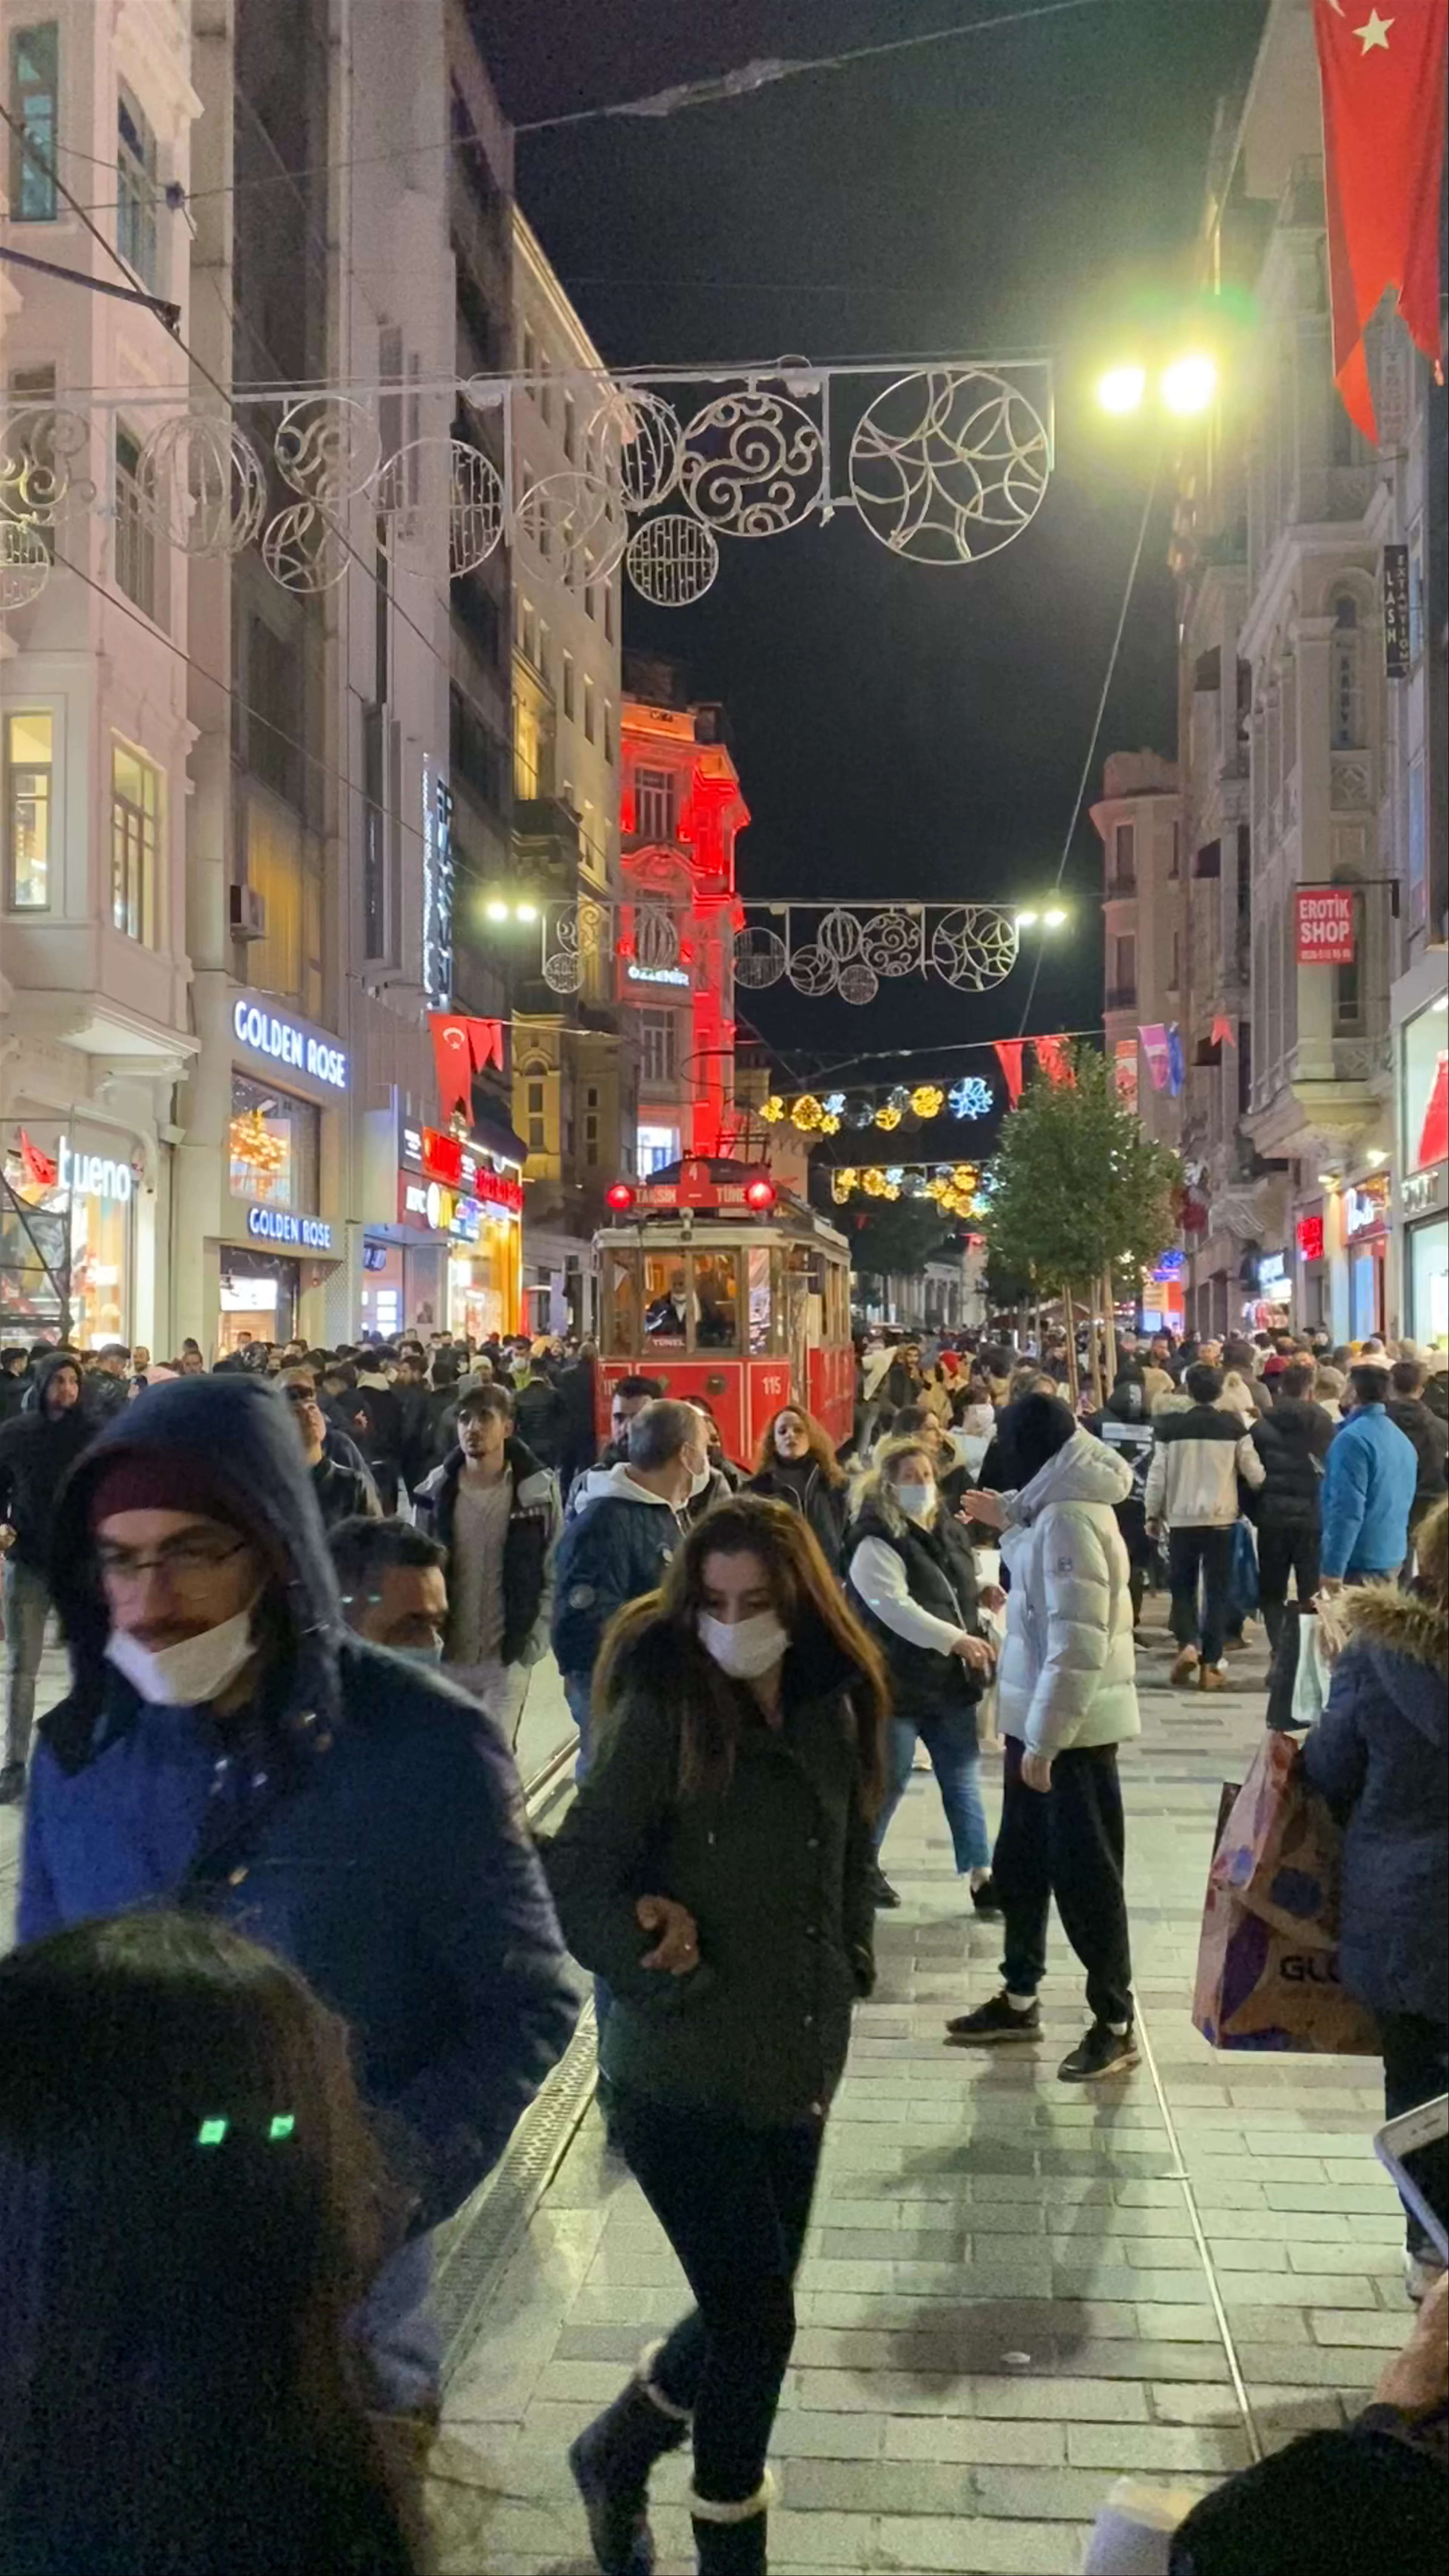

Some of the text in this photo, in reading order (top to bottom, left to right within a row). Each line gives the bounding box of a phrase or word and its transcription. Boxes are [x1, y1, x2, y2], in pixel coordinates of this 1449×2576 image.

[1300, 893, 1349, 919] EROTİK
[1300, 921, 1350, 944] SHOP
[234, 1000, 345, 1088] GOLDEN ROSE
[59, 1135, 131, 1201] bueno
[250, 1207, 331, 1248] GOLDEN ROSE
[762, 1376, 781, 1395] 115
